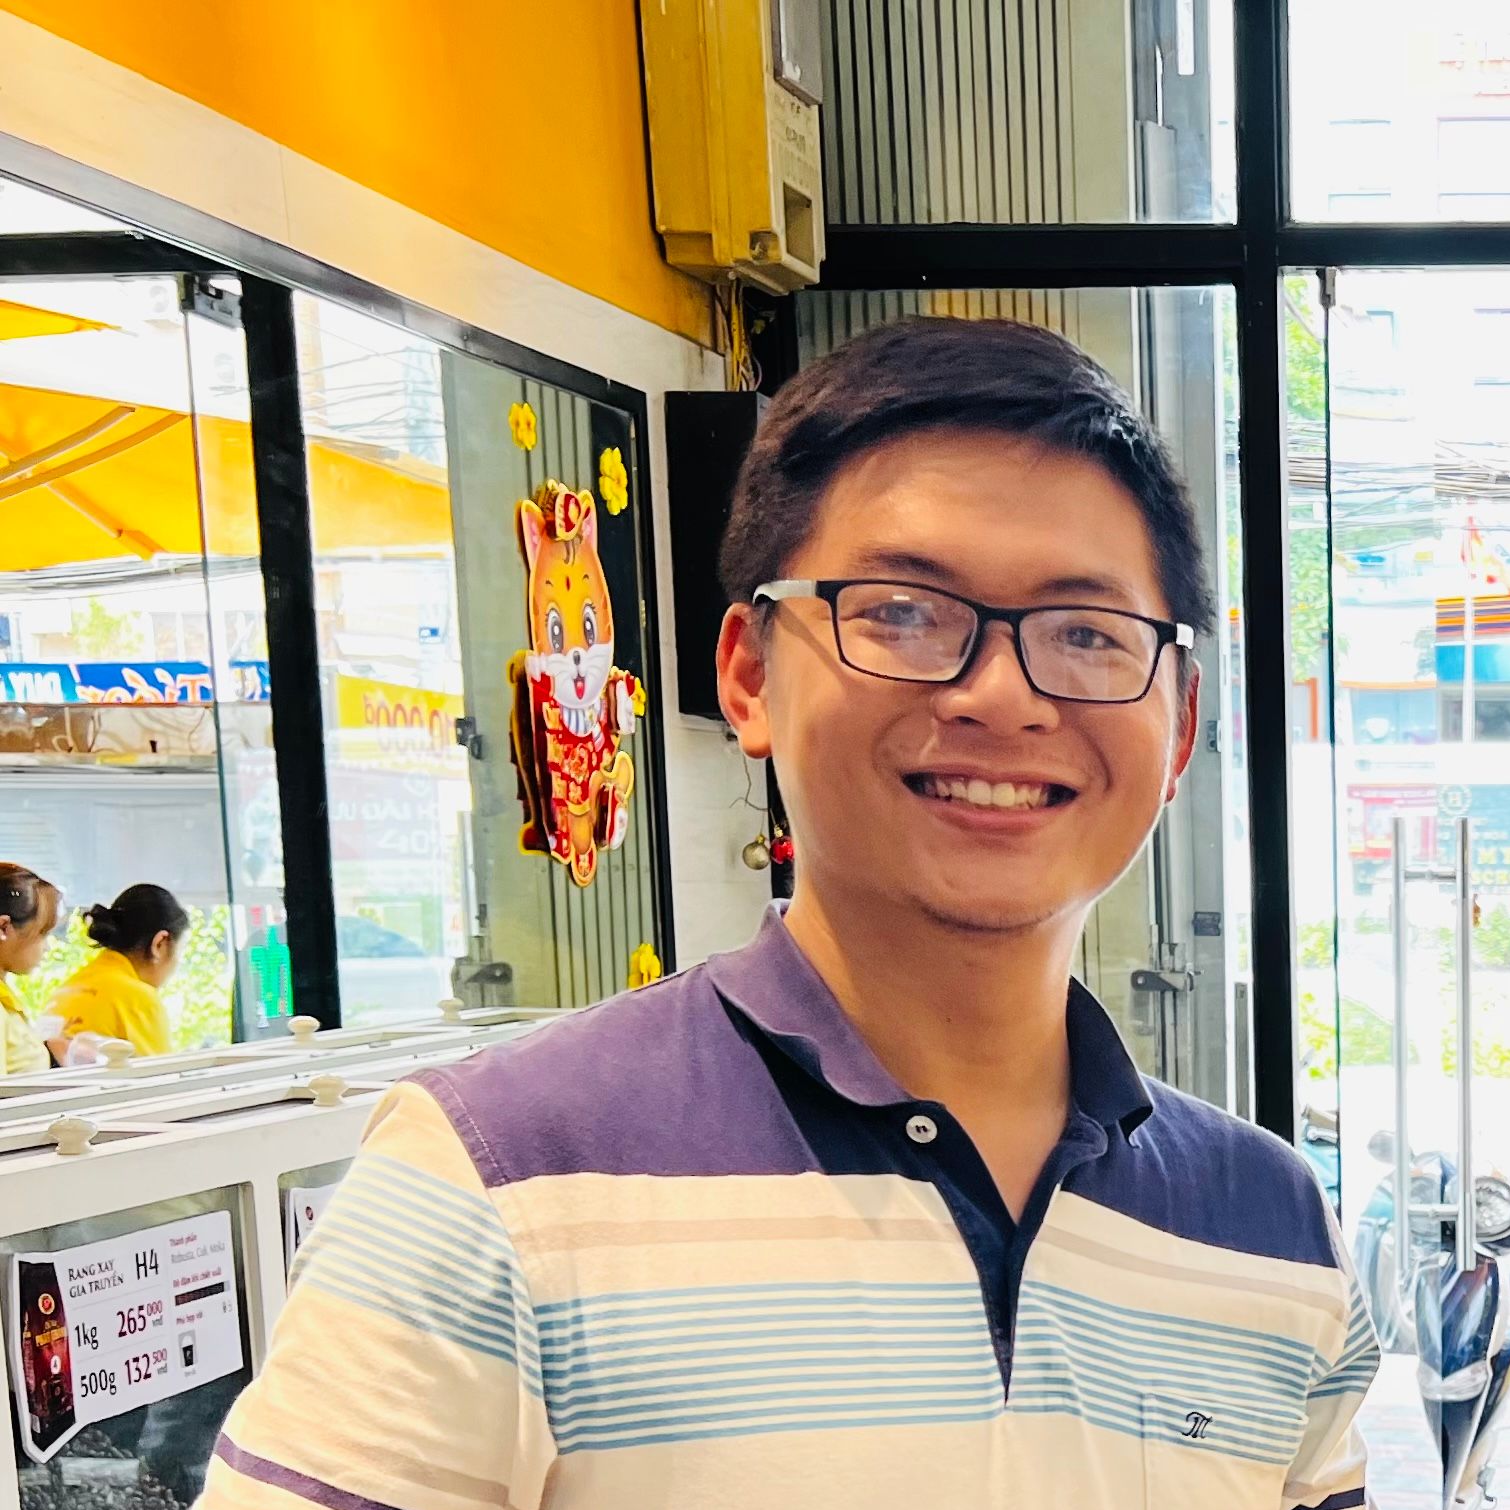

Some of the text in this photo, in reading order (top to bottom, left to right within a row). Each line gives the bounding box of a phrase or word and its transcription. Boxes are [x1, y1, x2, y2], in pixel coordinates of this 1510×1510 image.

[68, 1258, 115, 1282] RANG XAY
[135, 1248, 160, 1281] H4
[70, 1284, 87, 1298] GIA
[74, 1322, 99, 1350] 1kg
[116, 1304, 147, 1338] 265
[146, 1300, 163, 1316] 000
[80, 1348, 168, 1398] 500g 132 500
